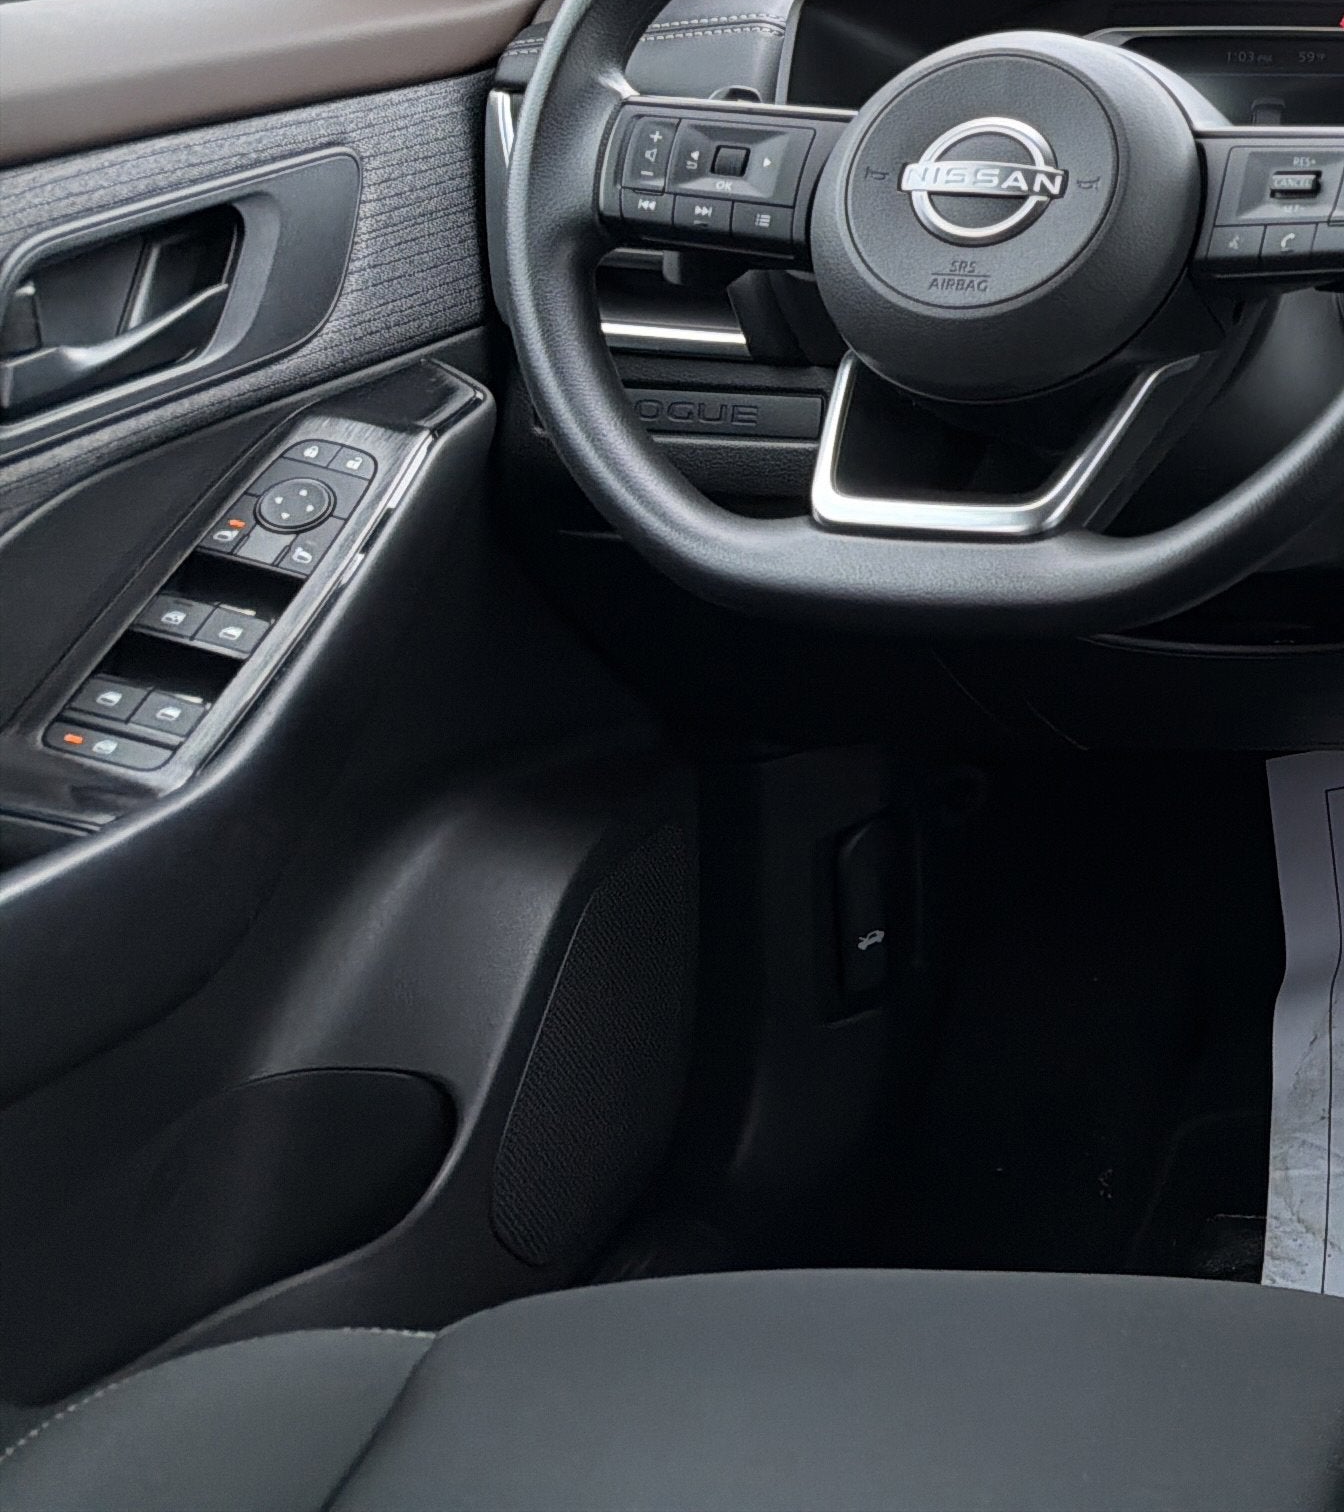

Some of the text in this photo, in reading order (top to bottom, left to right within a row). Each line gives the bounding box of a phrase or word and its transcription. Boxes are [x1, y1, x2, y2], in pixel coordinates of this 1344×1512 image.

[716, 181, 733, 191] OK
[906, 166, 1063, 195] NISSAN
[950, 260, 976, 274] SRS
[928, 277, 989, 292] AIRBAG
[634, 398, 760, 426] OGUE
